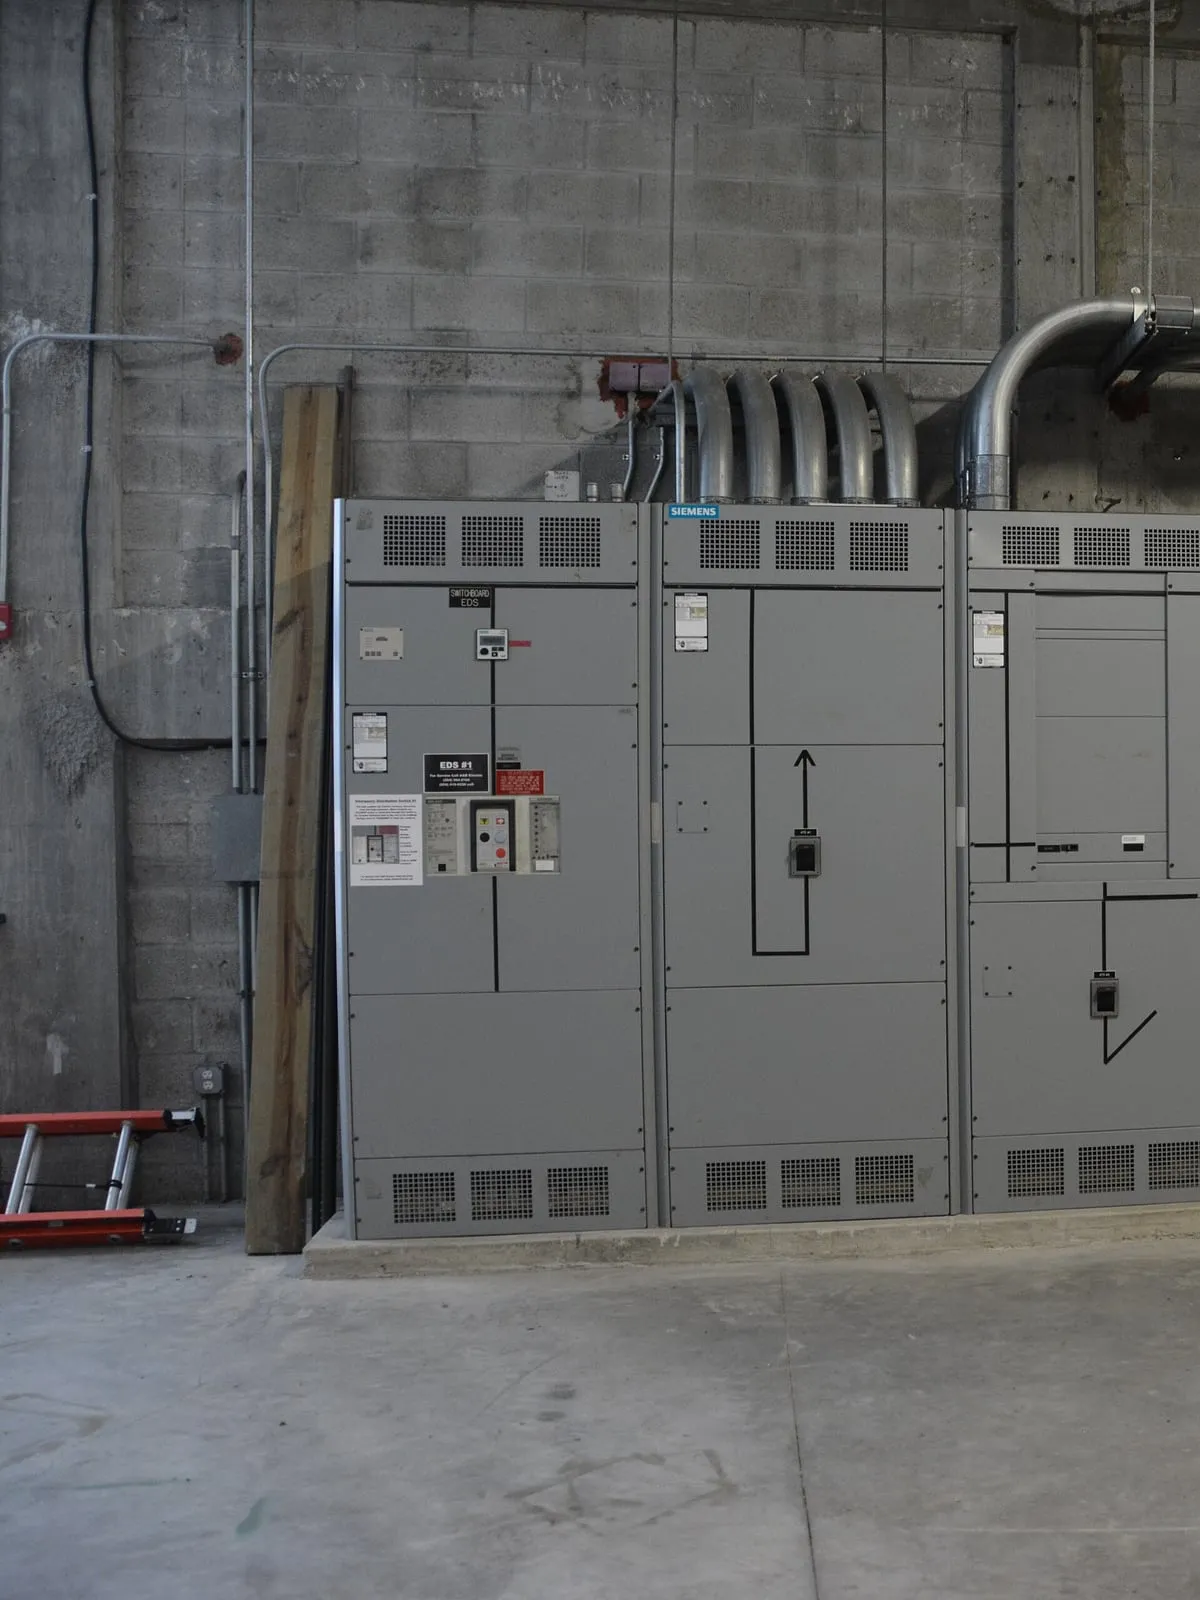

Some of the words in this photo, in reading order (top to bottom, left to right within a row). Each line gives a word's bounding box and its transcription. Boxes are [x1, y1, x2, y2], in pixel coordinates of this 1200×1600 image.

[671, 507, 716, 516] SIEMENS
[450, 589, 490, 598] SWITCHBOARD
[461, 598, 479, 607] EDS
[440, 761, 459, 769] EDS
[461, 761, 473, 769] #1
